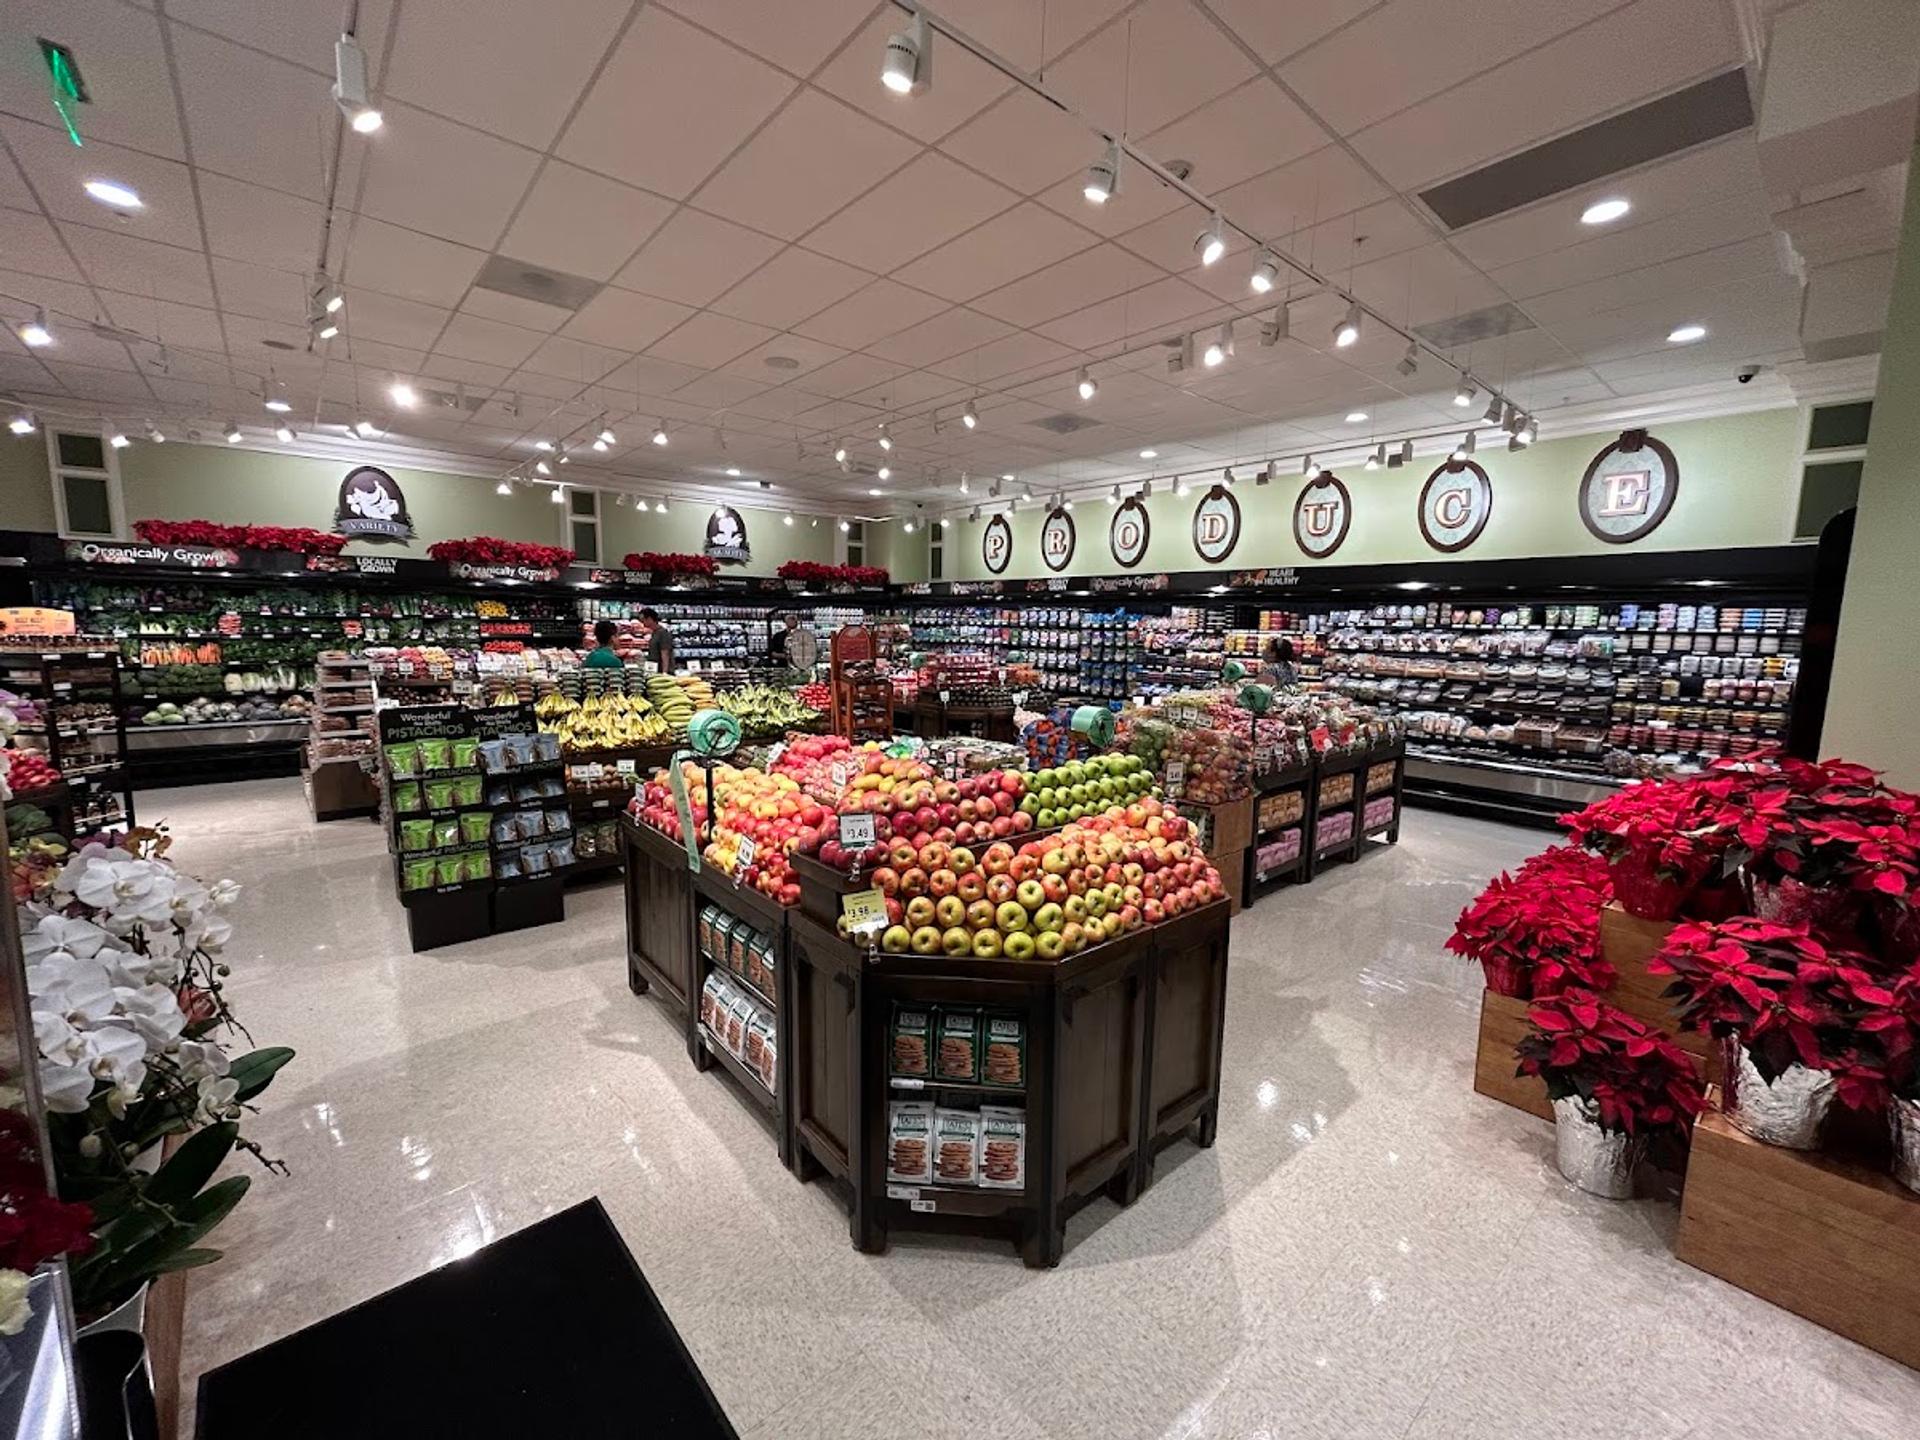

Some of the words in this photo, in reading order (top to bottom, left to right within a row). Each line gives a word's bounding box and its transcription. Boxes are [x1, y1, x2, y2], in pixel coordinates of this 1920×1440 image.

[84, 544, 169, 562] Organically
[173, 548, 223, 561] Grown
[356, 556, 398, 566] LOCALLY
[360, 565, 396, 574] GROWN
[461, 564, 516, 577] Organically
[518, 566, 550, 577] Grown
[1269, 567, 1295, 577] HEART
[1264, 576, 1300, 585] HEALTHY
[400, 710, 451, 722] Wonderful
[474, 711, 519, 722] Wonderful
[387, 723, 464, 739] PISTACHIOS
